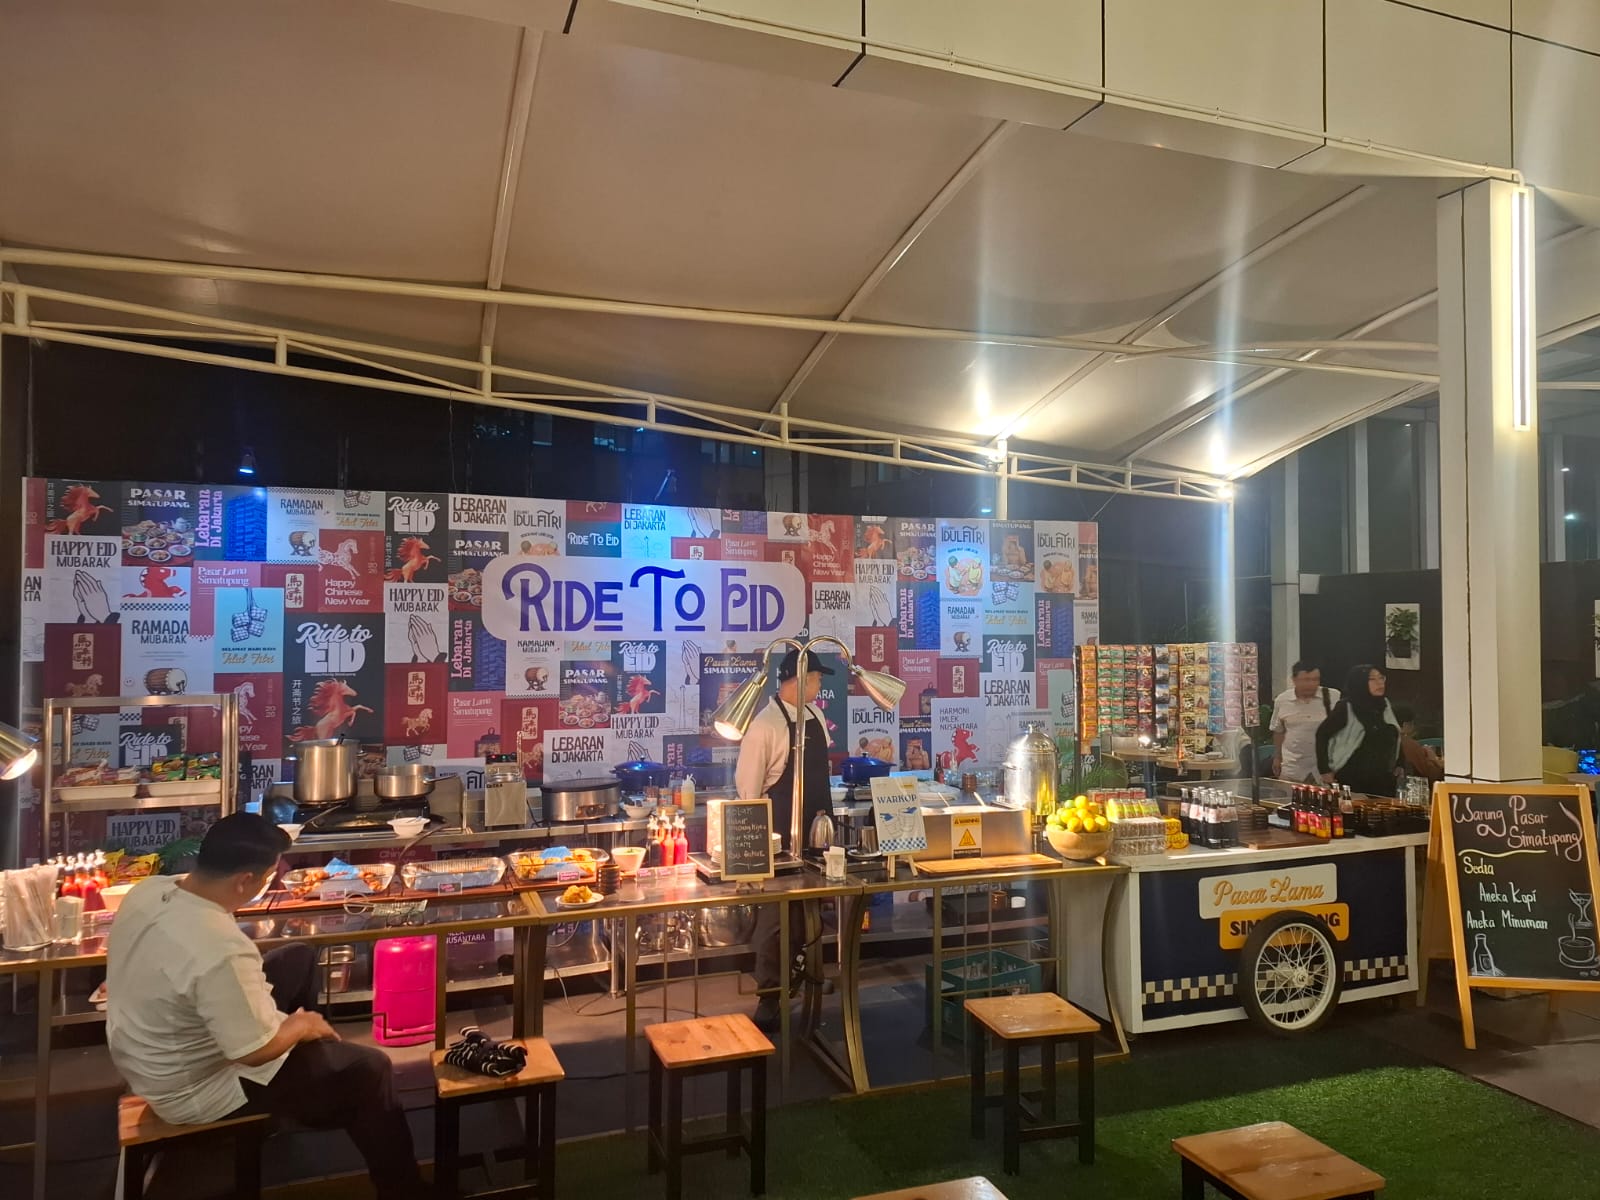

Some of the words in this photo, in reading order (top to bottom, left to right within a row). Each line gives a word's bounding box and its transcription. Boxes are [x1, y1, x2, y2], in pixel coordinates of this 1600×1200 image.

[130, 488, 186, 500] PASAR
[128, 500, 190, 508] SIMATUPANG
[280, 498, 323, 510] RAMADAN
[388, 496, 425, 512] Ride
[425, 501, 441, 511] to
[453, 497, 507, 513] LEBARAN
[195, 489, 211, 547] Lebaran
[210, 490, 222, 534] Jakarta
[453, 513, 461, 522] DI
[463, 512, 506, 524] JAKARTA
[624, 509, 666, 521] LEBARAN
[394, 511, 436, 532] EID
[633, 521, 666, 530] JAKARTA
[901, 523, 935, 531] PASAR
[51, 541, 94, 556] HAPPY
[96, 542, 117, 556] EID
[455, 540, 501, 550] PASAR
[56, 556, 111, 568] MUBARAK
[199, 567, 220, 575] Pasar
[856, 564, 880, 574] HAPPY
[882, 564, 894, 574] EID
[198, 577, 249, 586] Simatupang
[325, 579, 355, 589] Happy
[859, 575, 891, 584] MUBARAK
[325, 588, 363, 597] Chinese
[389, 589, 424, 602] HAPPY
[428, 589, 444, 600] EID
[502, 563, 623, 631] RIDE
[720, 568, 785, 632] EID
[815, 590, 850, 601] LEBARAN
[325, 597, 347, 606] New
[349, 597, 370, 606] Year
[394, 602, 439, 612] MUBARAK
[815, 601, 821, 610] DI
[823, 600, 850, 610] JAKARTA
[899, 588, 907, 638] Lebaran
[947, 606, 975, 615] RAMADAN
[140, 635, 187, 644] MUBARAK
[296, 623, 347, 645] Ride
[350, 624, 372, 641] to
[462, 620, 472, 661] Jakarta
[451, 619, 463, 678] Lebaran
[618, 641, 646, 655] Ride
[647, 643, 659, 653] to
[987, 639, 1016, 653] Ride
[1017, 643, 1028, 651] to
[305, 639, 366, 673] EID
[623, 653, 656, 672] EID
[704, 656, 729, 667] Pasar
[731, 656, 757, 666] Lama
[992, 653, 1024, 672] EID
[565, 669, 605, 678] PASAR
[984, 680, 1030, 694] LEBARAN
[453, 698, 470, 707] Pasar
[985, 695, 992, 707] DI
[994, 694, 1030, 706] JAKARTA
[453, 707, 493, 715] Simatupang
[612, 716, 640, 729] HAPPY
[644, 715, 659, 727] EID
[120, 732, 156, 746] Ride
[159, 734, 174, 744] to
[616, 730, 654, 739] MUBARAK
[552, 736, 604, 751] LEBARAN
[552, 752, 560, 763] DI
[561, 751, 604, 762] JAKARTA
[877, 794, 917, 805] WARKOP
[1452, 795, 1507, 837] Warung
[1509, 795, 1548, 825] Pasar
[112, 820, 153, 837] HAPPY
[156, 819, 176, 834] EID
[1507, 825, 1583, 862] Simatupang
[1464, 856, 1494, 875] Sedia
[1213, 880, 1268, 906] Pasar
[1270, 876, 1324, 902] Lama
[1480, 882, 1508, 903] Aneka
[1509, 882, 1536, 912] Kopi
[1466, 910, 1495, 929] Aneka
[1501, 910, 1548, 929] Minuman
